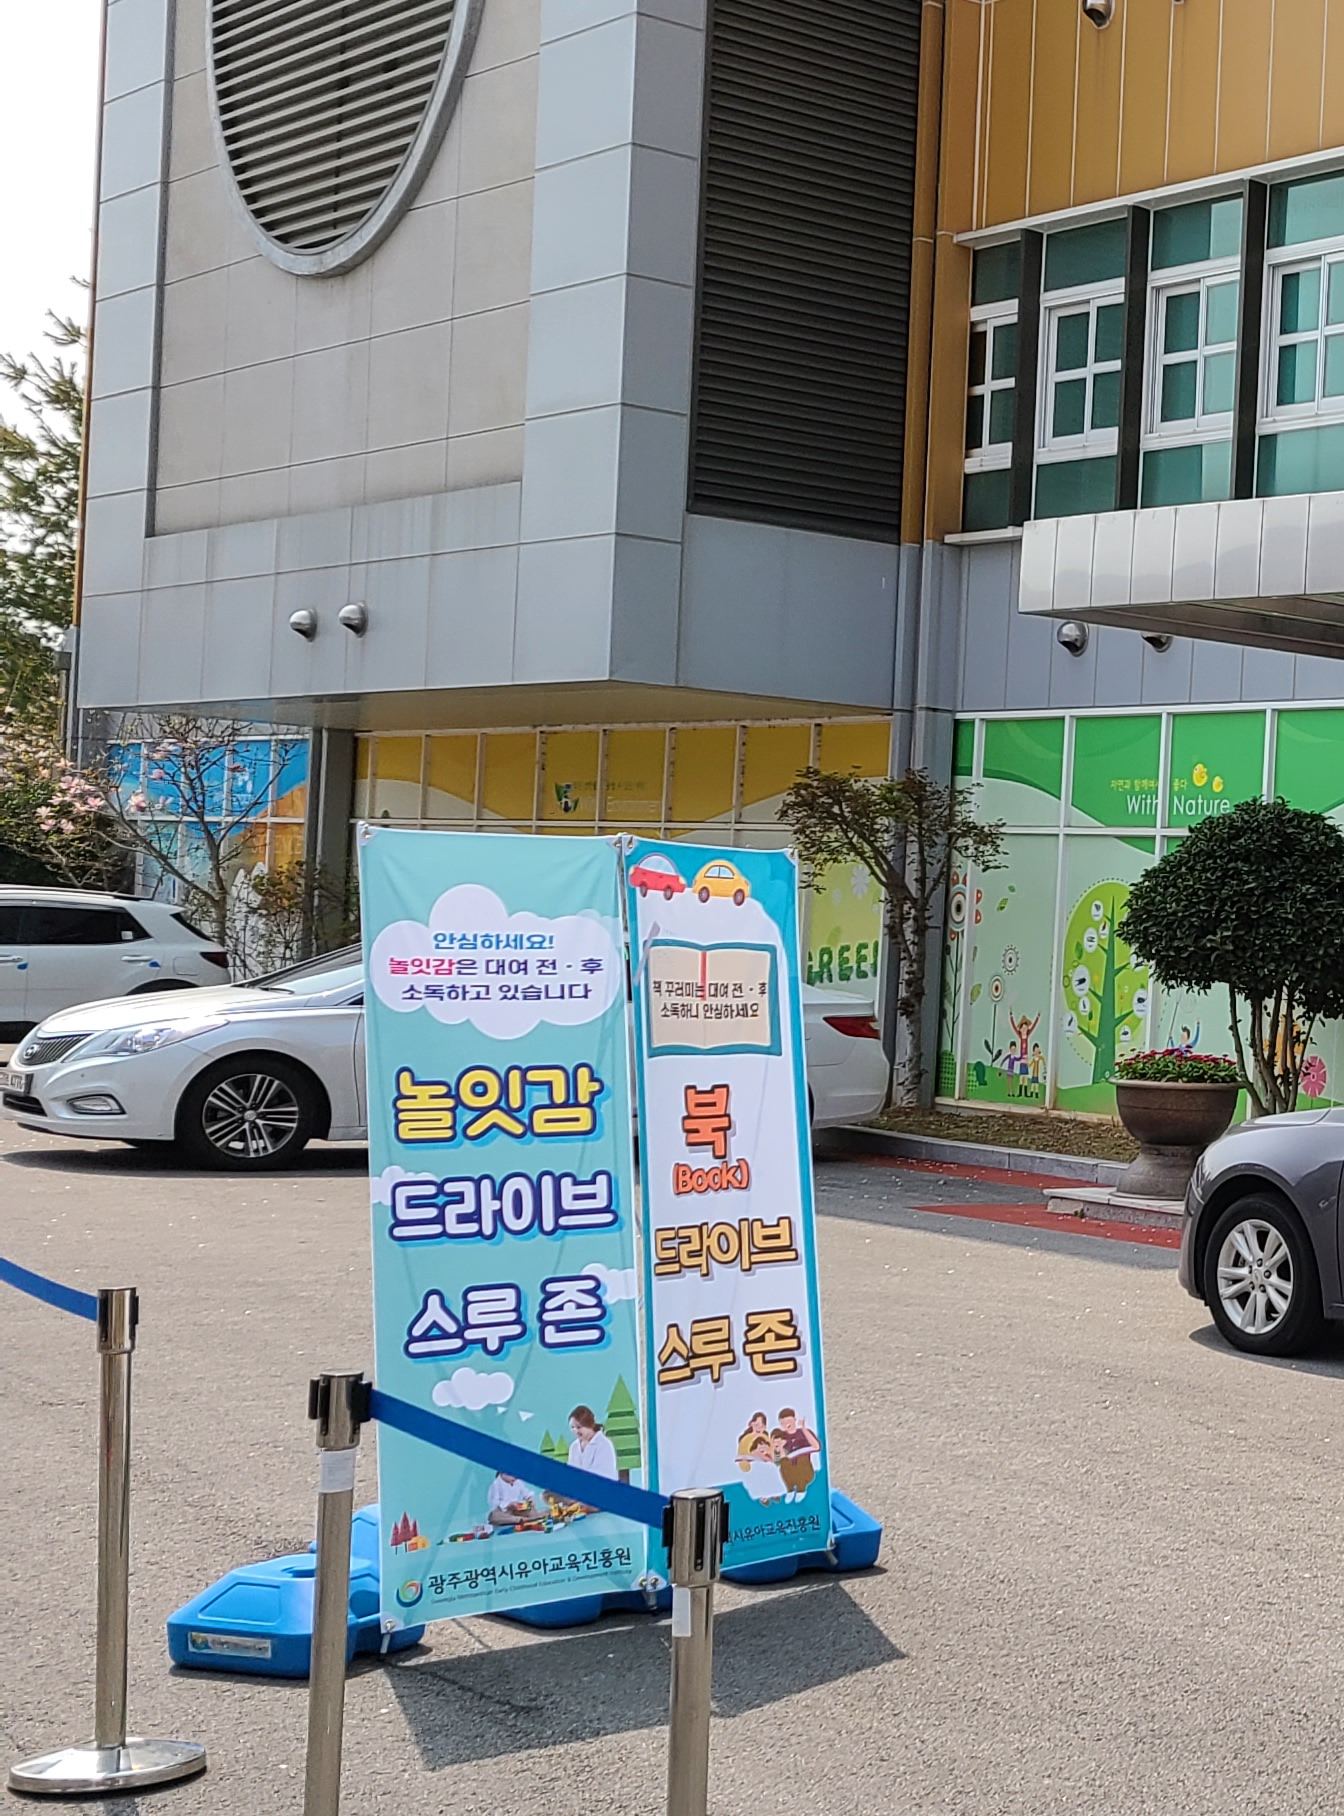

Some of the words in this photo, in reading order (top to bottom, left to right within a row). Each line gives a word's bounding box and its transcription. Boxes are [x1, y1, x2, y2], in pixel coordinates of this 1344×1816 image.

[1173, 794, 1230, 815] Nature
[432, 932, 555, 950] 안심하세요!
[389, 957, 478, 976] 놀잇감은
[485, 958, 529, 976] 대여
[401, 984, 492, 1001] 소독하고
[499, 983, 592, 1001] 있습니다
[665, 981, 705, 998] 꾸러미는
[708, 982, 728, 998] 대여
[660, 1002, 699, 1019] 소독하니
[703, 1003, 759, 1020] 안심하세요
[392, 1063, 604, 1143] 놀잇감
[682, 1083, 732, 1159] 북
[673, 1158, 750, 1194] (Book)
[389, 1170, 618, 1241] 드라이브
[653, 1217, 798, 1277] 드라이브
[403, 1283, 527, 1358] 스루
[537, 1275, 606, 1348] 존
[657, 1315, 736, 1386] 스루
[743, 1308, 801, 1376] 존
[727, 1515, 820, 1545] 시유아교육진흥원
[428, 1547, 632, 1595] 광주광역시유아교육진흥원
